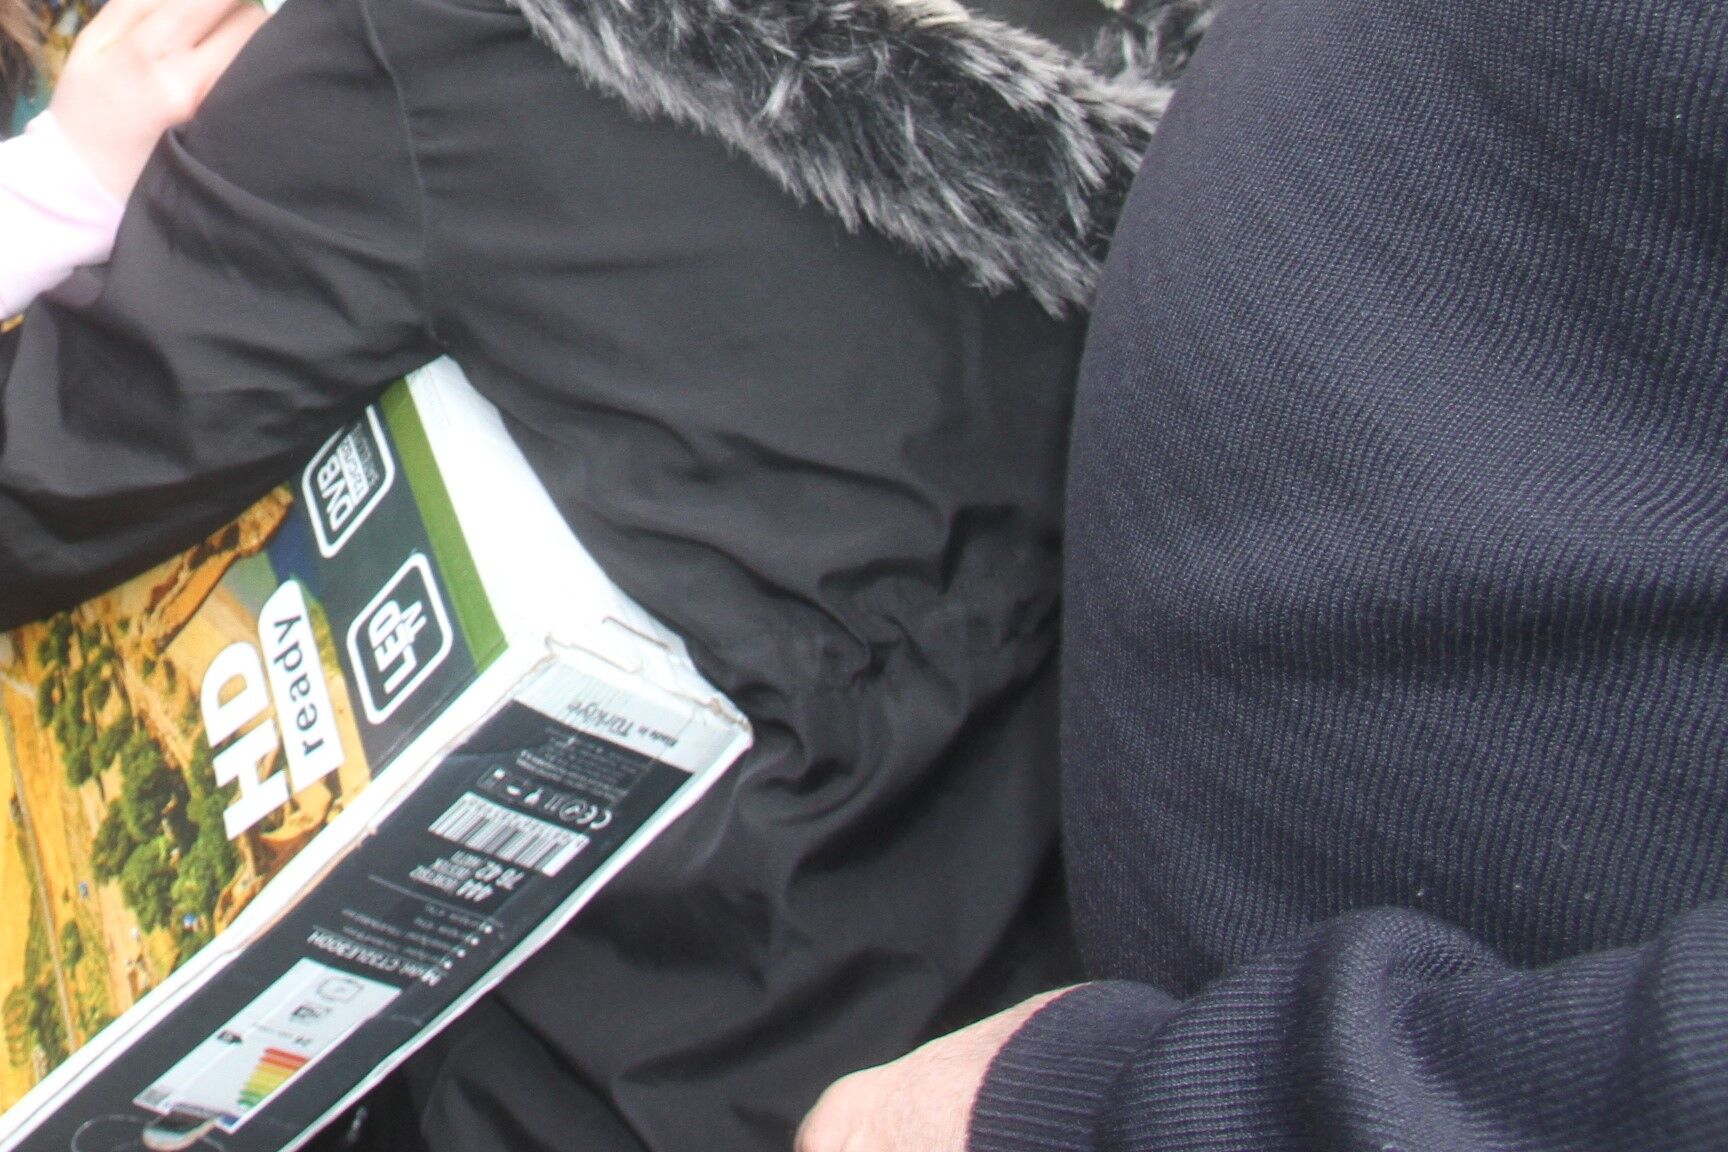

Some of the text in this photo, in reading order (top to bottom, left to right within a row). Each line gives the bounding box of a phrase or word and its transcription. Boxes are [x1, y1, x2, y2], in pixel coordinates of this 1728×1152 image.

[317, 453, 355, 532] DVB
[368, 599, 417, 695] LED
[399, 599, 427, 645] TV
[273, 613, 325, 757] ready
[563, 699, 634, 738] Türkiye
[201, 641, 290, 841] HD
